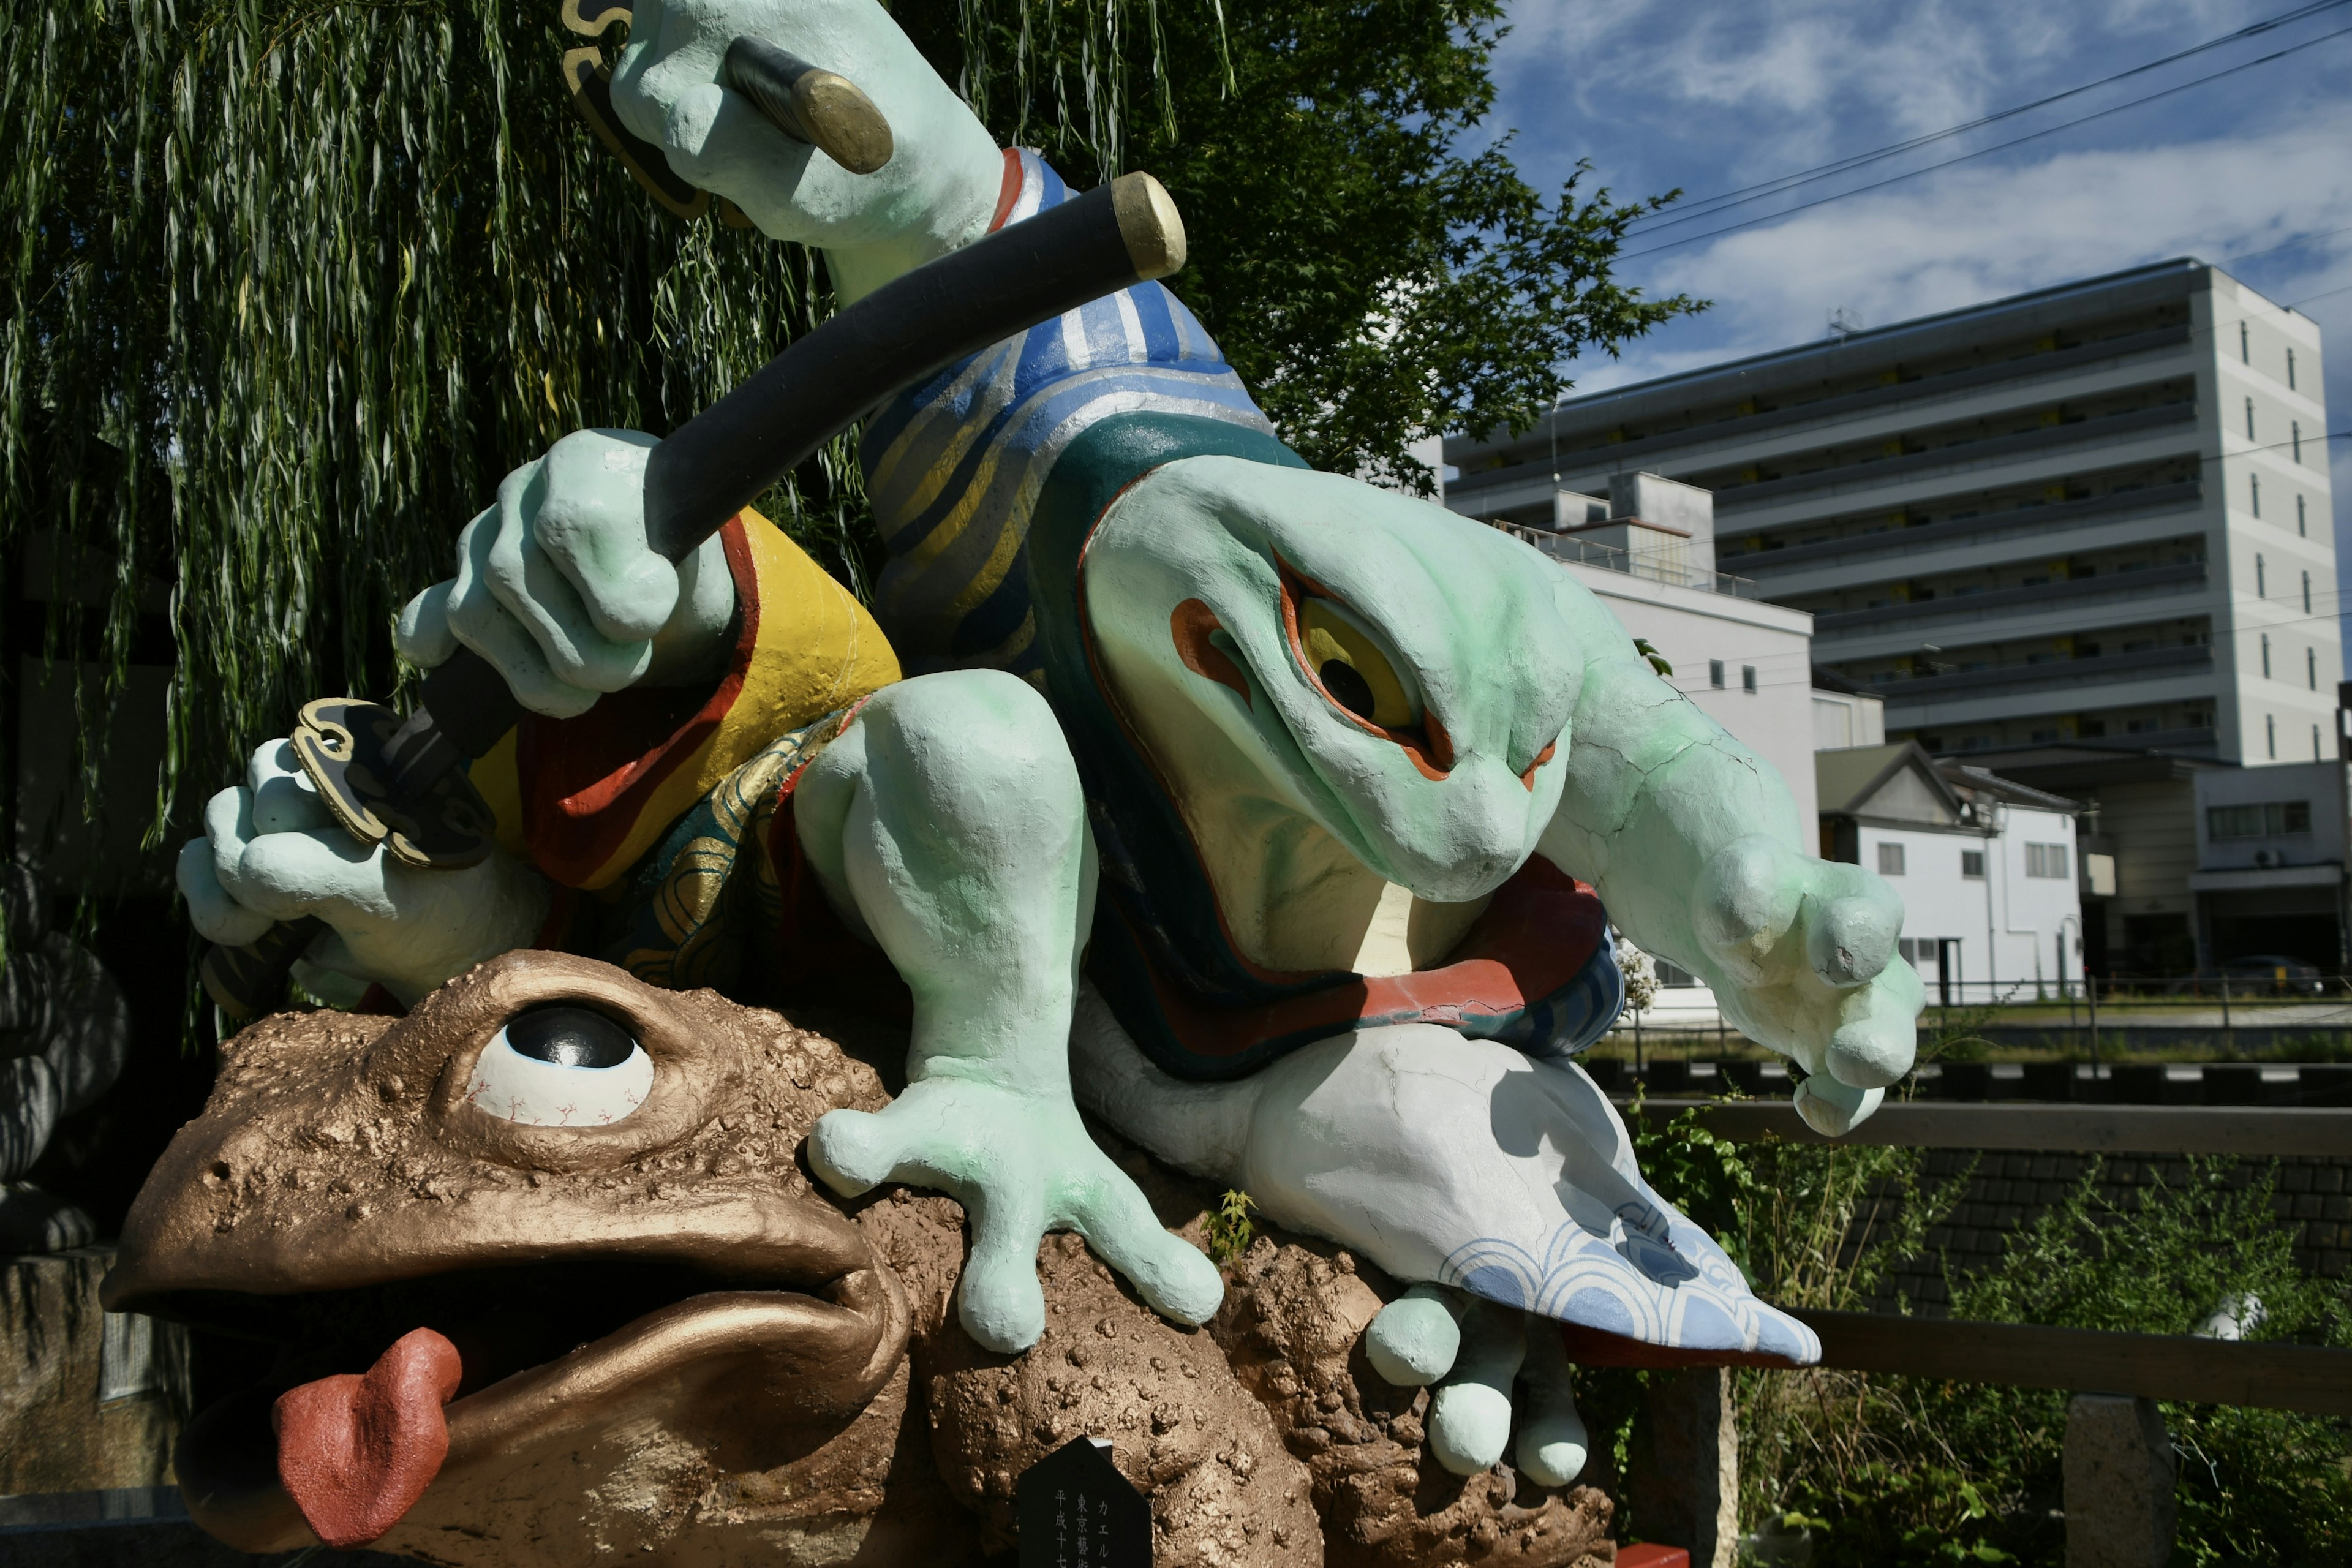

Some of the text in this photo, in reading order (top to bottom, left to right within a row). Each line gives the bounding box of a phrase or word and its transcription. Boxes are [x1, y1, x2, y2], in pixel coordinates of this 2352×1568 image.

[1055, 1490, 1067, 1568] 平成十七
[1098, 1501, 1109, 1568] カエル
